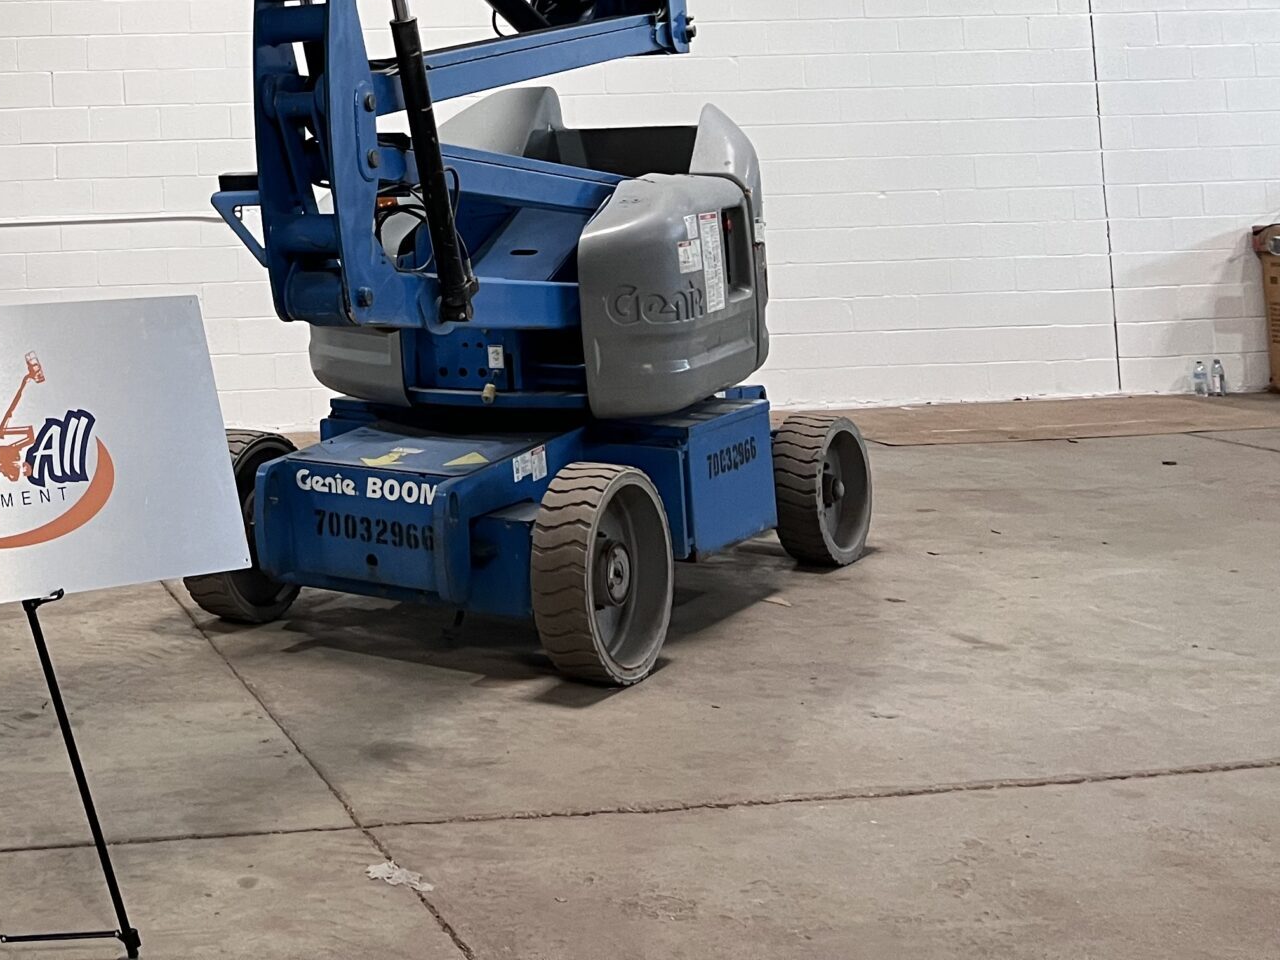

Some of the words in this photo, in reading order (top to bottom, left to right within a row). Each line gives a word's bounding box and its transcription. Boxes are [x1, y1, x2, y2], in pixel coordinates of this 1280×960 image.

[28, 411, 92, 484] All
[295, 468, 357, 496] Genie
[314, 508, 435, 552] 70032966
